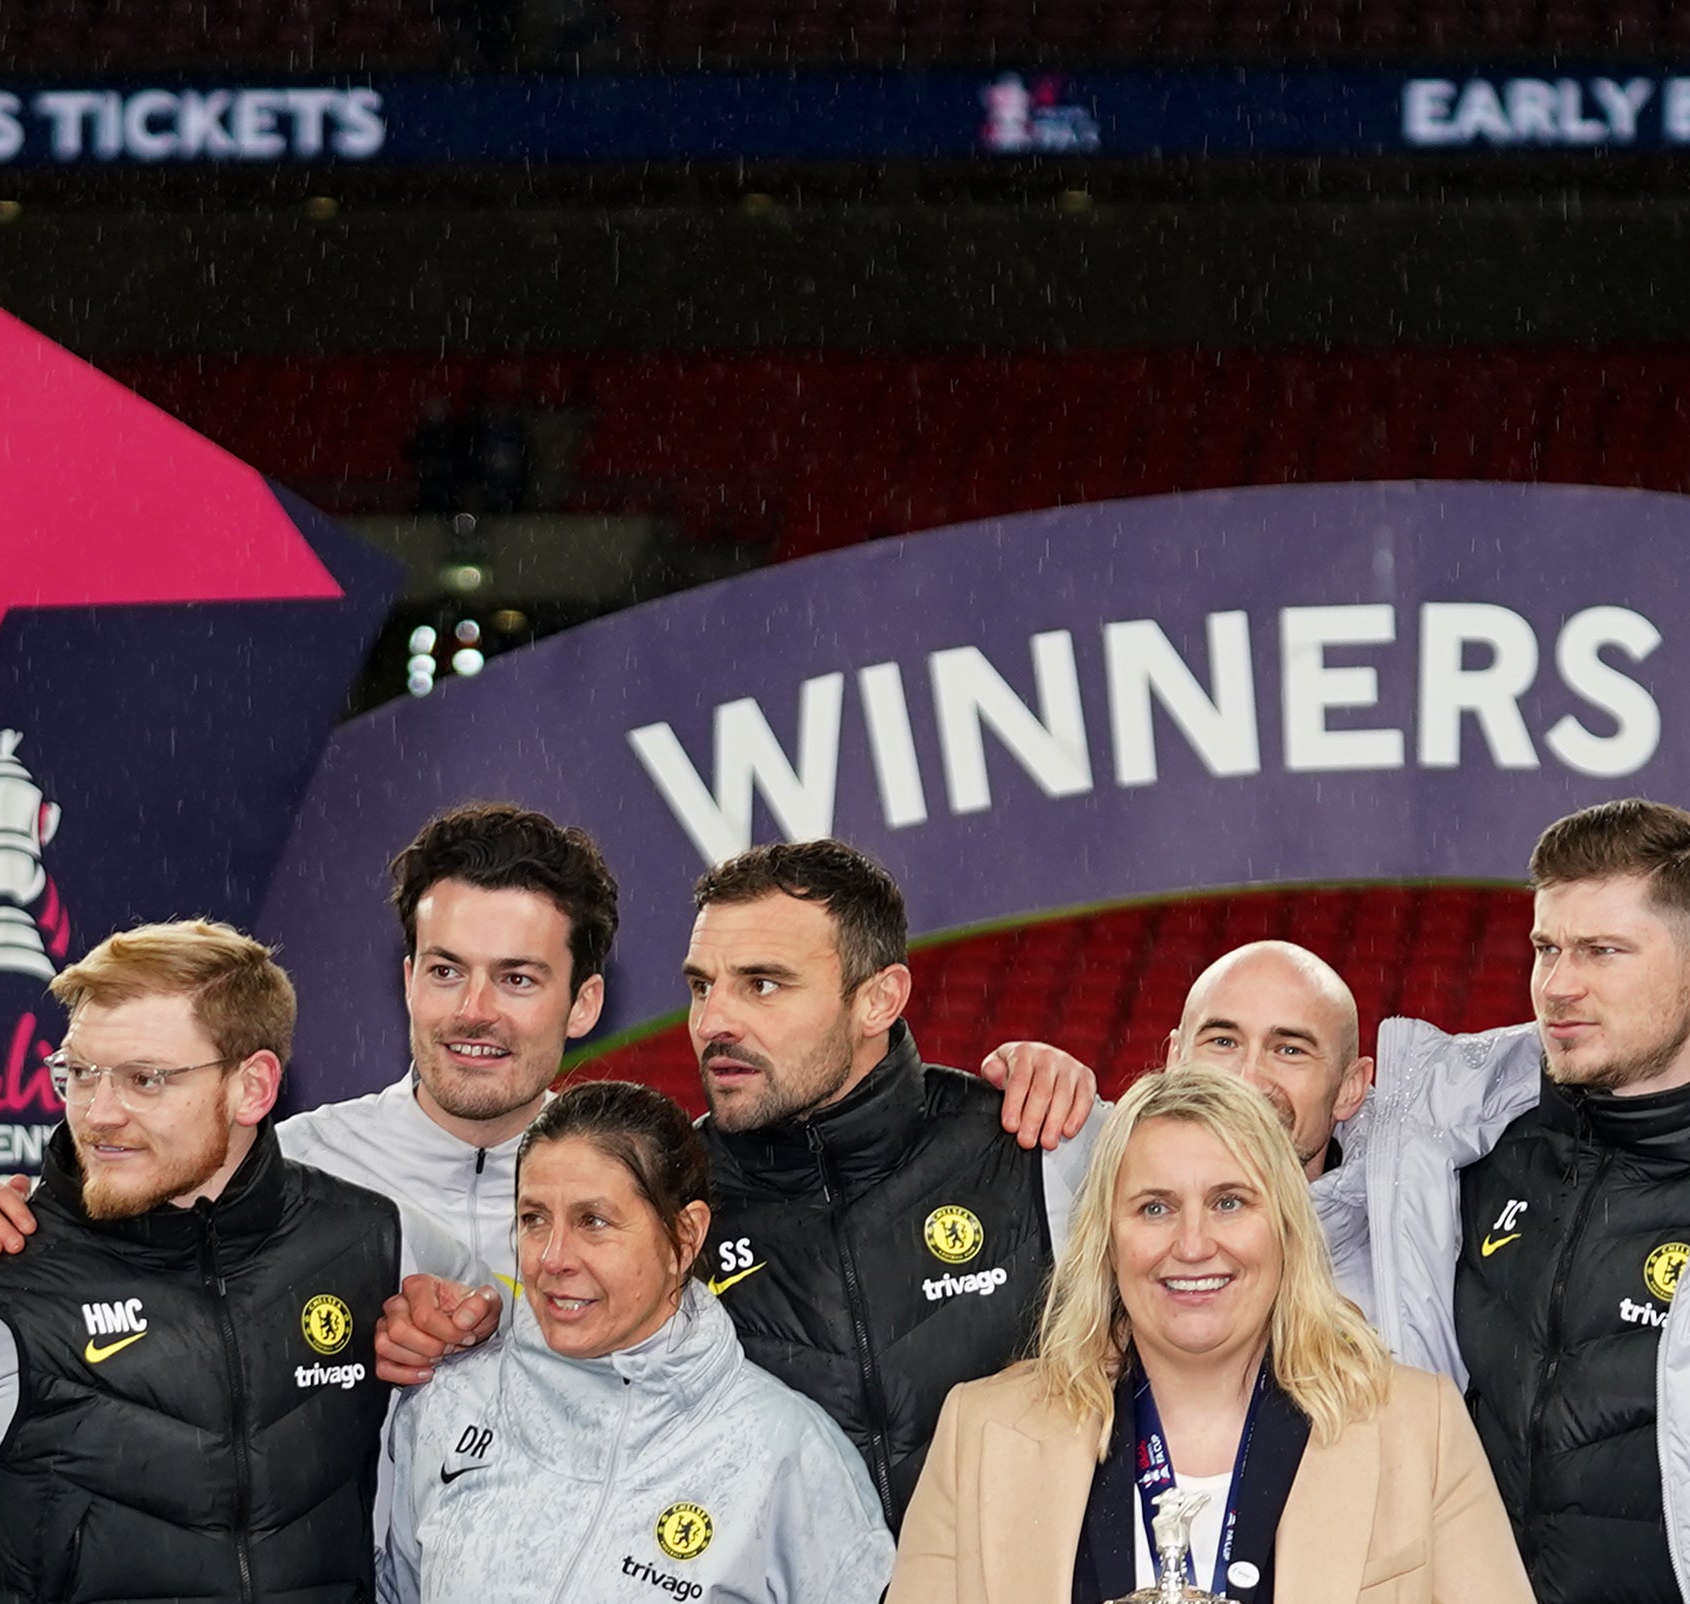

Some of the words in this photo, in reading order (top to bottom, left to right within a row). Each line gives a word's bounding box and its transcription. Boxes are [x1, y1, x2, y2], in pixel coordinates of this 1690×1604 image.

[37, 87, 385, 158] TICKETS
[1405, 76, 1653, 144] EARLY
[628, 603, 1664, 868] WINNERS
[718, 1237, 755, 1272] SS
[922, 1267, 1007, 1300] trivago
[81, 1298, 148, 1335] HMC
[294, 1362, 366, 1390] trivago
[455, 1424, 494, 1459] DR
[621, 1555, 703, 1602] trivago
